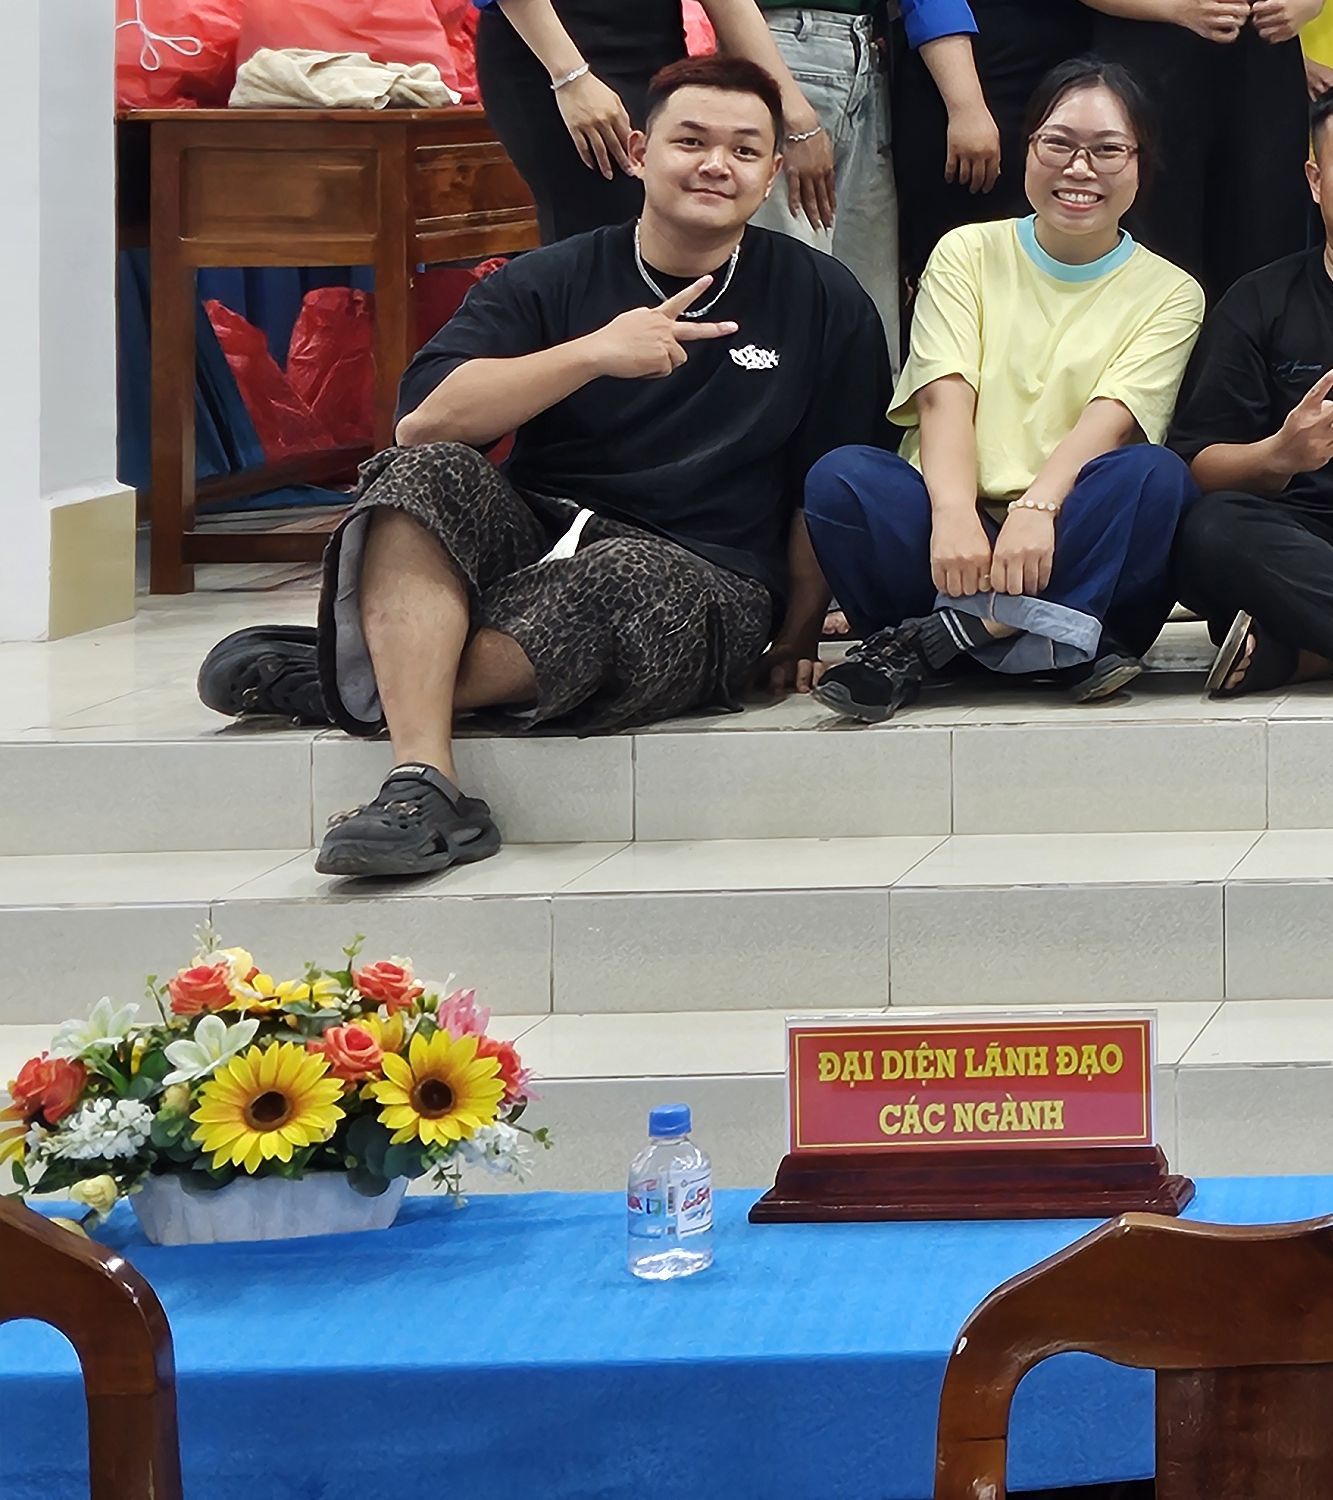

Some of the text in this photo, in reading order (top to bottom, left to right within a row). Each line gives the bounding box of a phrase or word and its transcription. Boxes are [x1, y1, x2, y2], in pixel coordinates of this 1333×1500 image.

[817, 1041, 1124, 1089] ĐẠI DIỆN LÃNH ĐẠO
[878, 1093, 1065, 1136] CÁC NGÀNH
